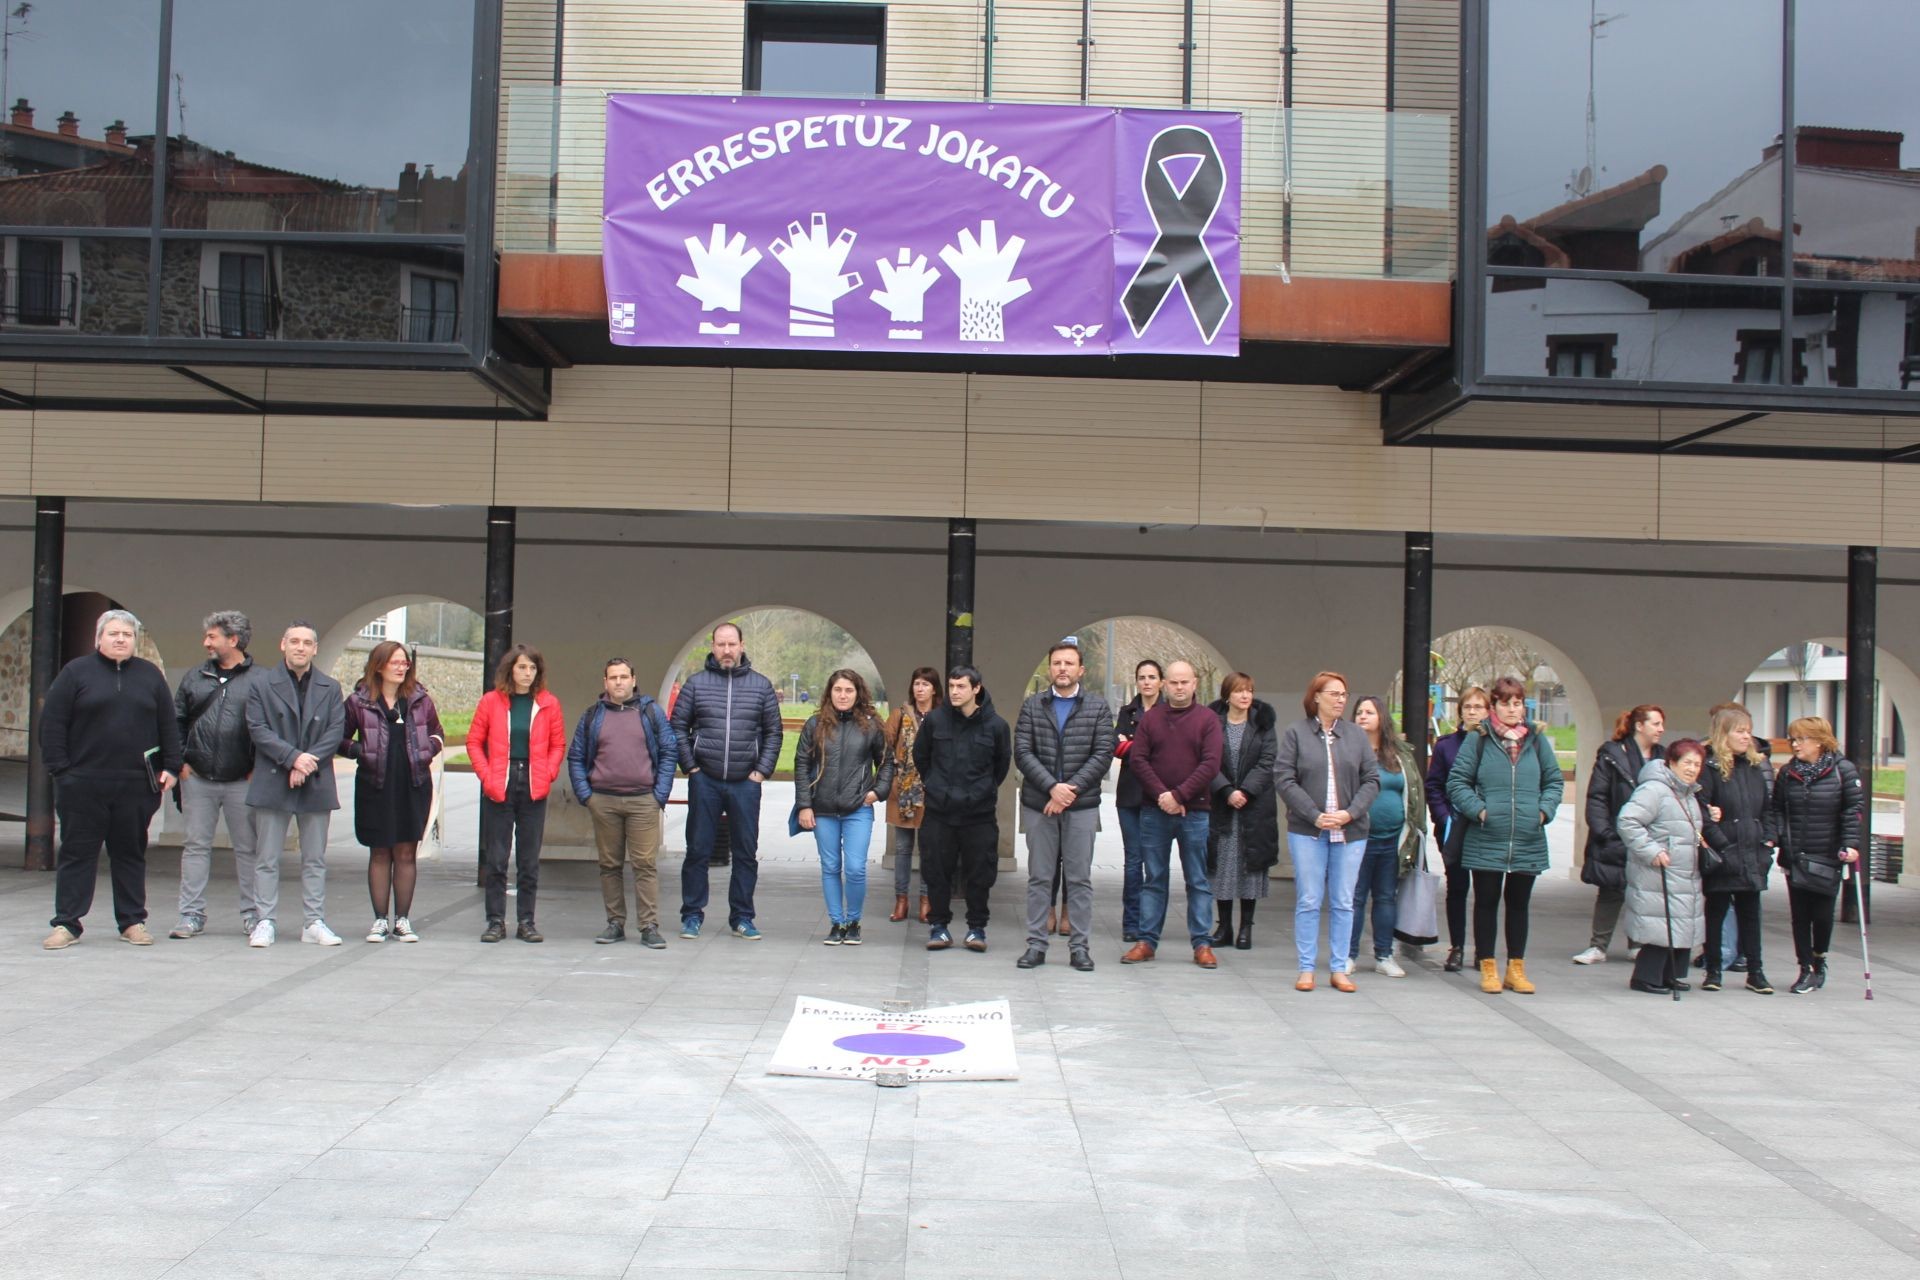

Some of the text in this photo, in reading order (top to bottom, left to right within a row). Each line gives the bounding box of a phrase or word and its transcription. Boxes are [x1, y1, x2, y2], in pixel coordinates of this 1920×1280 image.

[646, 114, 1075, 218] ERRESPETUZ JOKATU
[876, 1023, 926, 1032] EZ
[860, 1056, 931, 1067] NO
